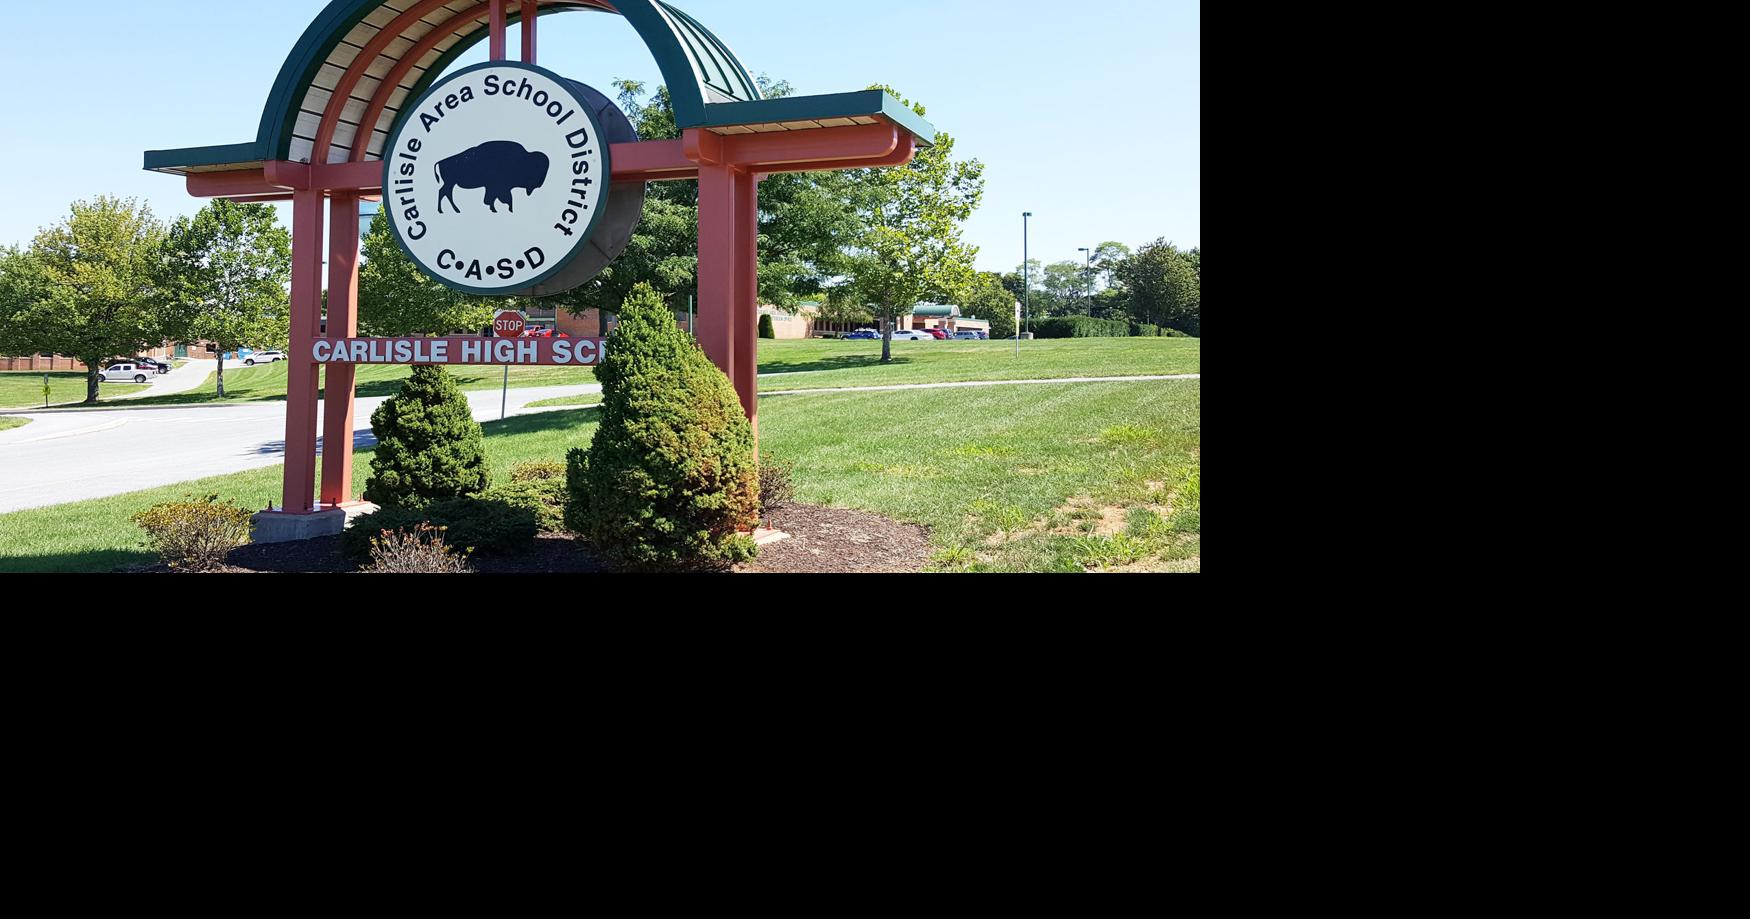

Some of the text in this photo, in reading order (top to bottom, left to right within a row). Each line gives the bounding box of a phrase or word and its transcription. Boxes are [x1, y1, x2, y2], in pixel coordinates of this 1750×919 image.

[394, 74, 593, 241] Carlisle Area School District
[495, 319, 523, 331] STOP
[312, 339, 448, 364] CARLISLE
[461, 339, 538, 364] HIGH
